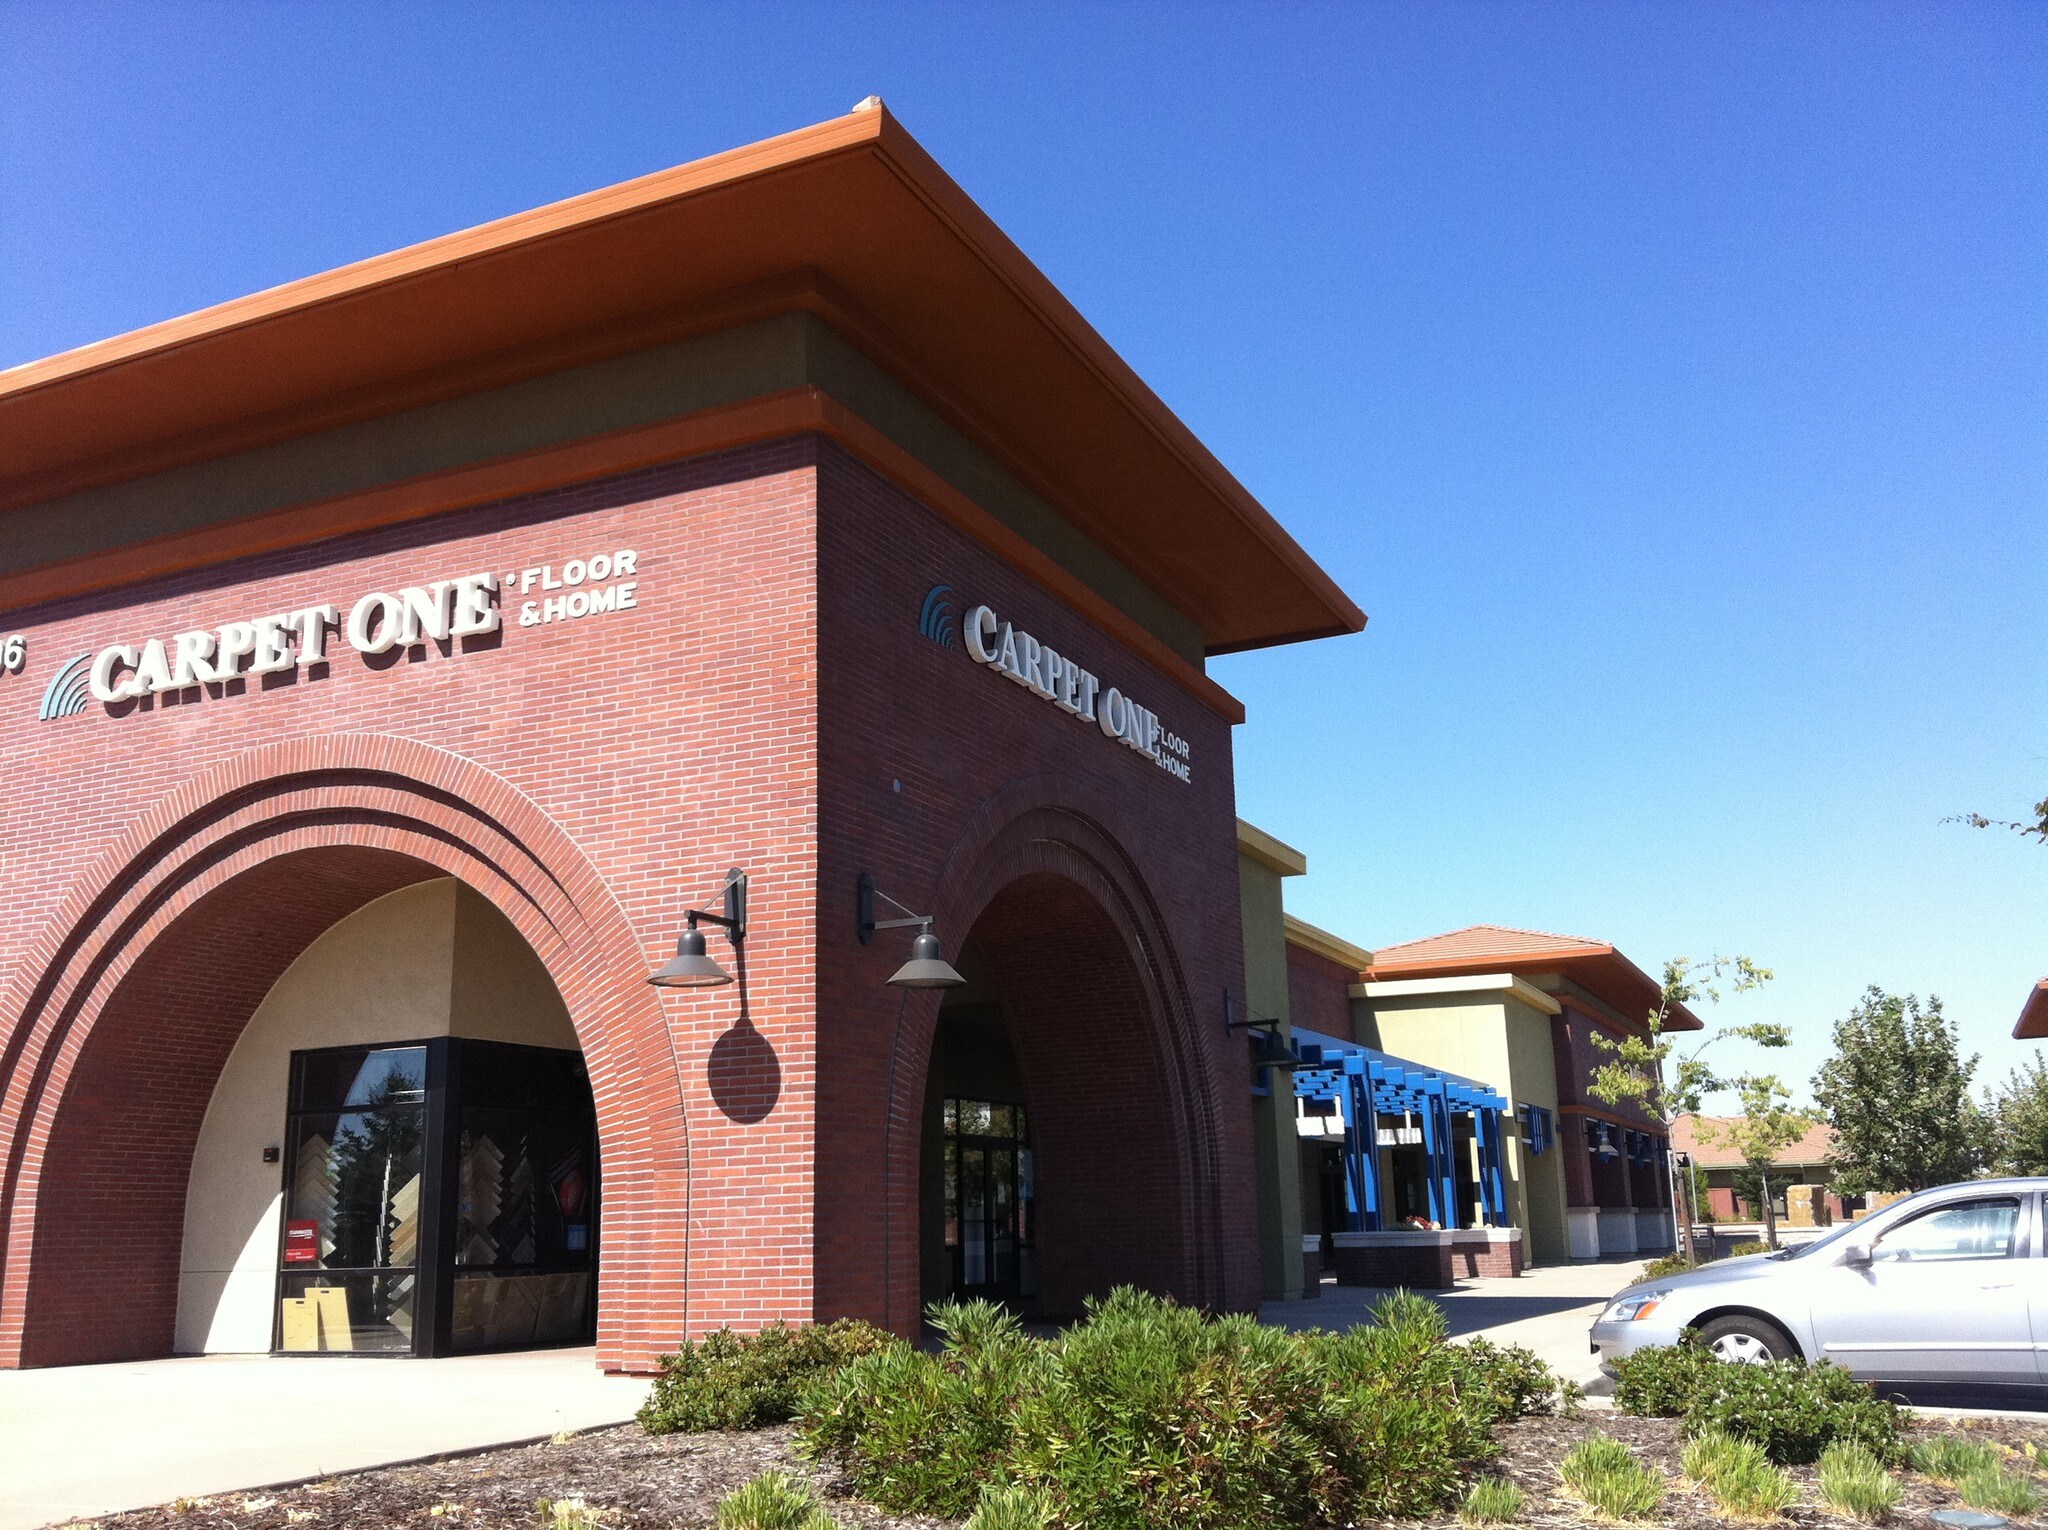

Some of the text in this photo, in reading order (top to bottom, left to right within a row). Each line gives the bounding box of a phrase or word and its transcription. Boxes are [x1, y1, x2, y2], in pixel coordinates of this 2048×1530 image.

[521, 550, 638, 594] FLOOR
[519, 582, 638, 627] &HOME
[0, 634, 26, 670] 6
[90, 573, 501, 702] CARPET ONE
[964, 605, 1159, 760] CARPET ONE
